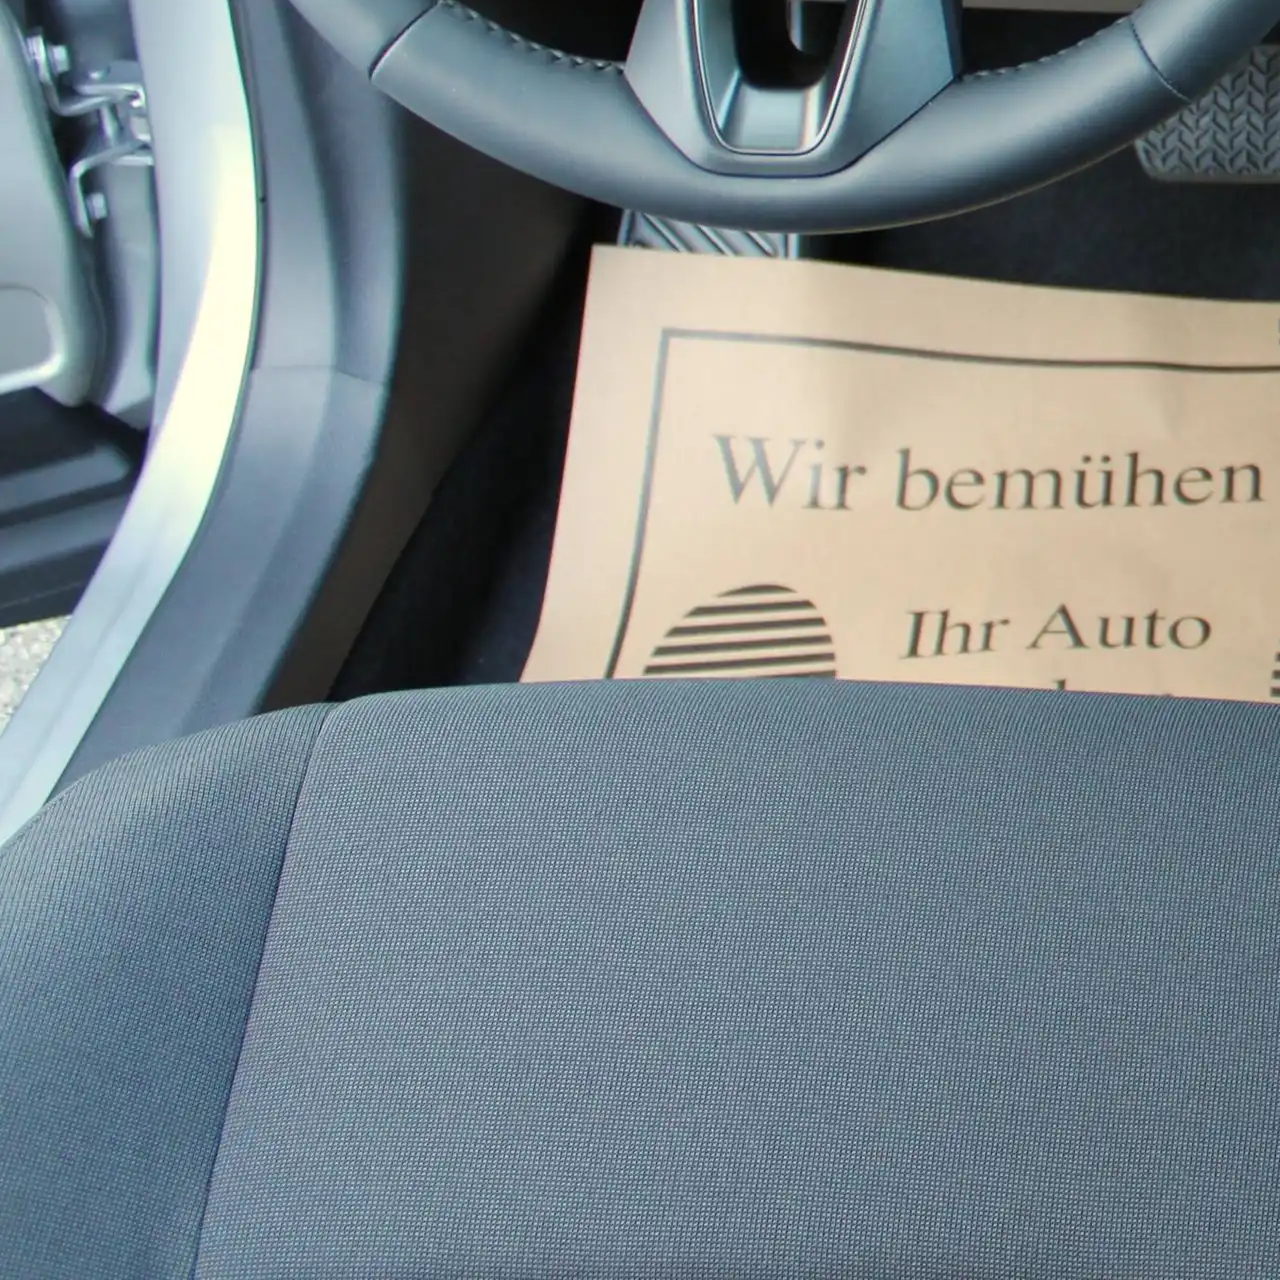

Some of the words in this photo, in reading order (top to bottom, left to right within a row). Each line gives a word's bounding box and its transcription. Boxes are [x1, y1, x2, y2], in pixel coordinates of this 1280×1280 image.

[712, 433, 868, 512] Wir
[894, 446, 1267, 512] bemühen
[898, 608, 1011, 661] Ihr
[1025, 603, 1213, 651] Auto
